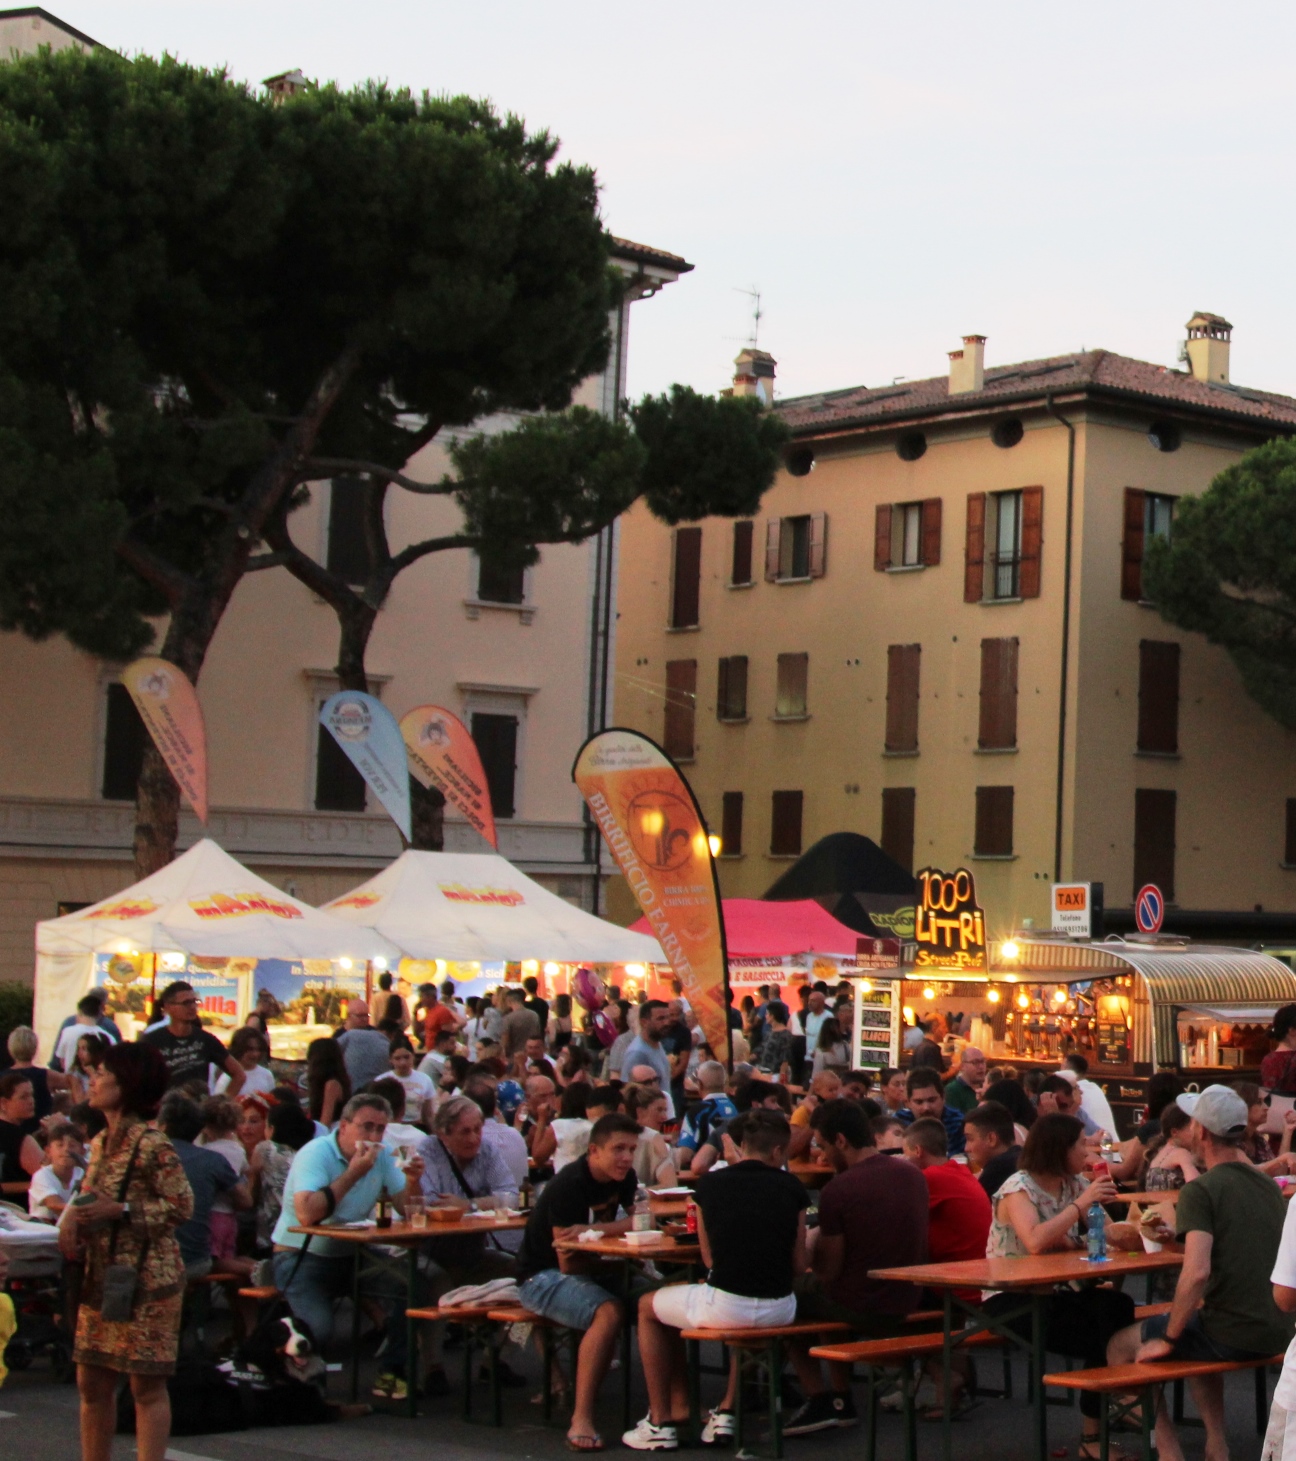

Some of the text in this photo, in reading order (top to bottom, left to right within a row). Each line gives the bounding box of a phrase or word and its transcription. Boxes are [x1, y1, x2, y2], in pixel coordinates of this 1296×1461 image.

[589, 791, 655, 907] BIRRIFICIO
[649, 906, 704, 1000] FARNESE
[920, 871, 970, 912] 1000
[1058, 893, 1084, 905] TAXI
[1060, 914, 1082, 922] Telefono
[743, 971, 786, 982] SALSICCIA
